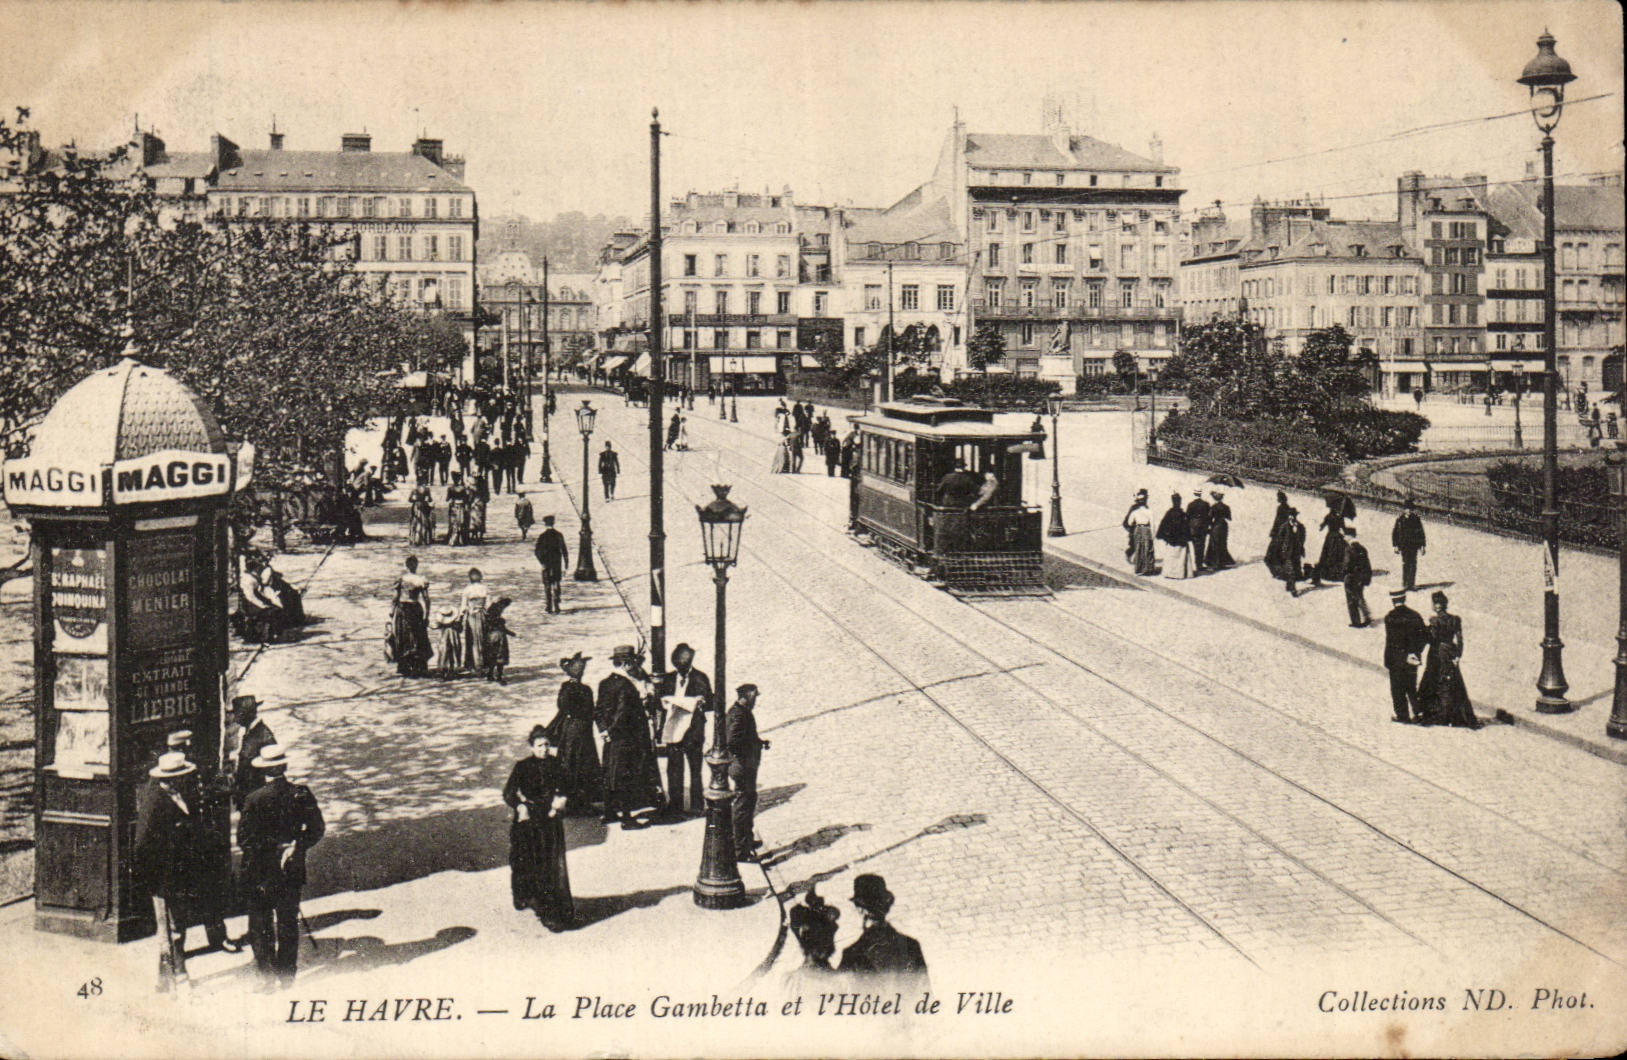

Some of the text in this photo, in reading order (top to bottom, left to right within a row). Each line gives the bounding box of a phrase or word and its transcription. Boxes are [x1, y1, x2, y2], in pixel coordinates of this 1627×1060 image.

[9, 468, 96, 492] MAGGI
[117, 460, 226, 493] MAGGI
[132, 664, 194, 684] EXTRAIT
[130, 693, 197, 725] LIEBIG
